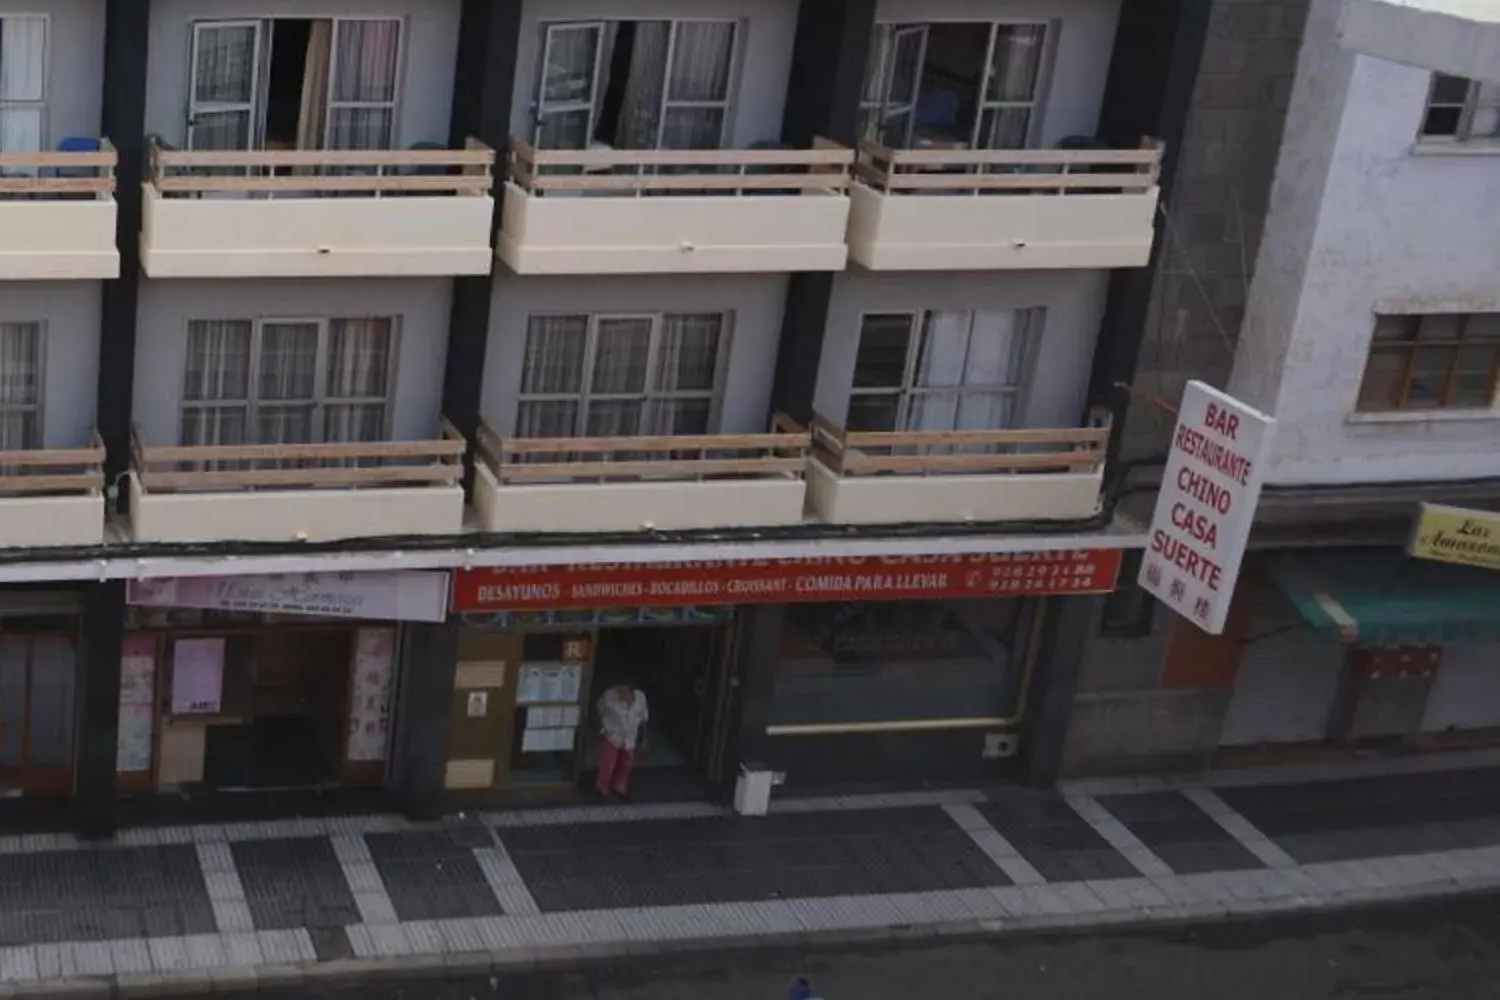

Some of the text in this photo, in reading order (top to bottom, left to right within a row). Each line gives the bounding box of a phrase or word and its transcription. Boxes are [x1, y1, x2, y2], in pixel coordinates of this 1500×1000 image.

[1204, 403, 1240, 439] BAR
[1174, 424, 1252, 486] RESTAURANTE
[1177, 466, 1231, 515] CHINO
[1171, 502, 1218, 549] CASA
[1151, 529, 1222, 592] SUERTE
[477, 583, 560, 602] DESAYUNOS
[795, 573, 851, 592] COMIDA
[855, 572, 892, 590] PARA
[897, 571, 947, 590] LLEVAR
